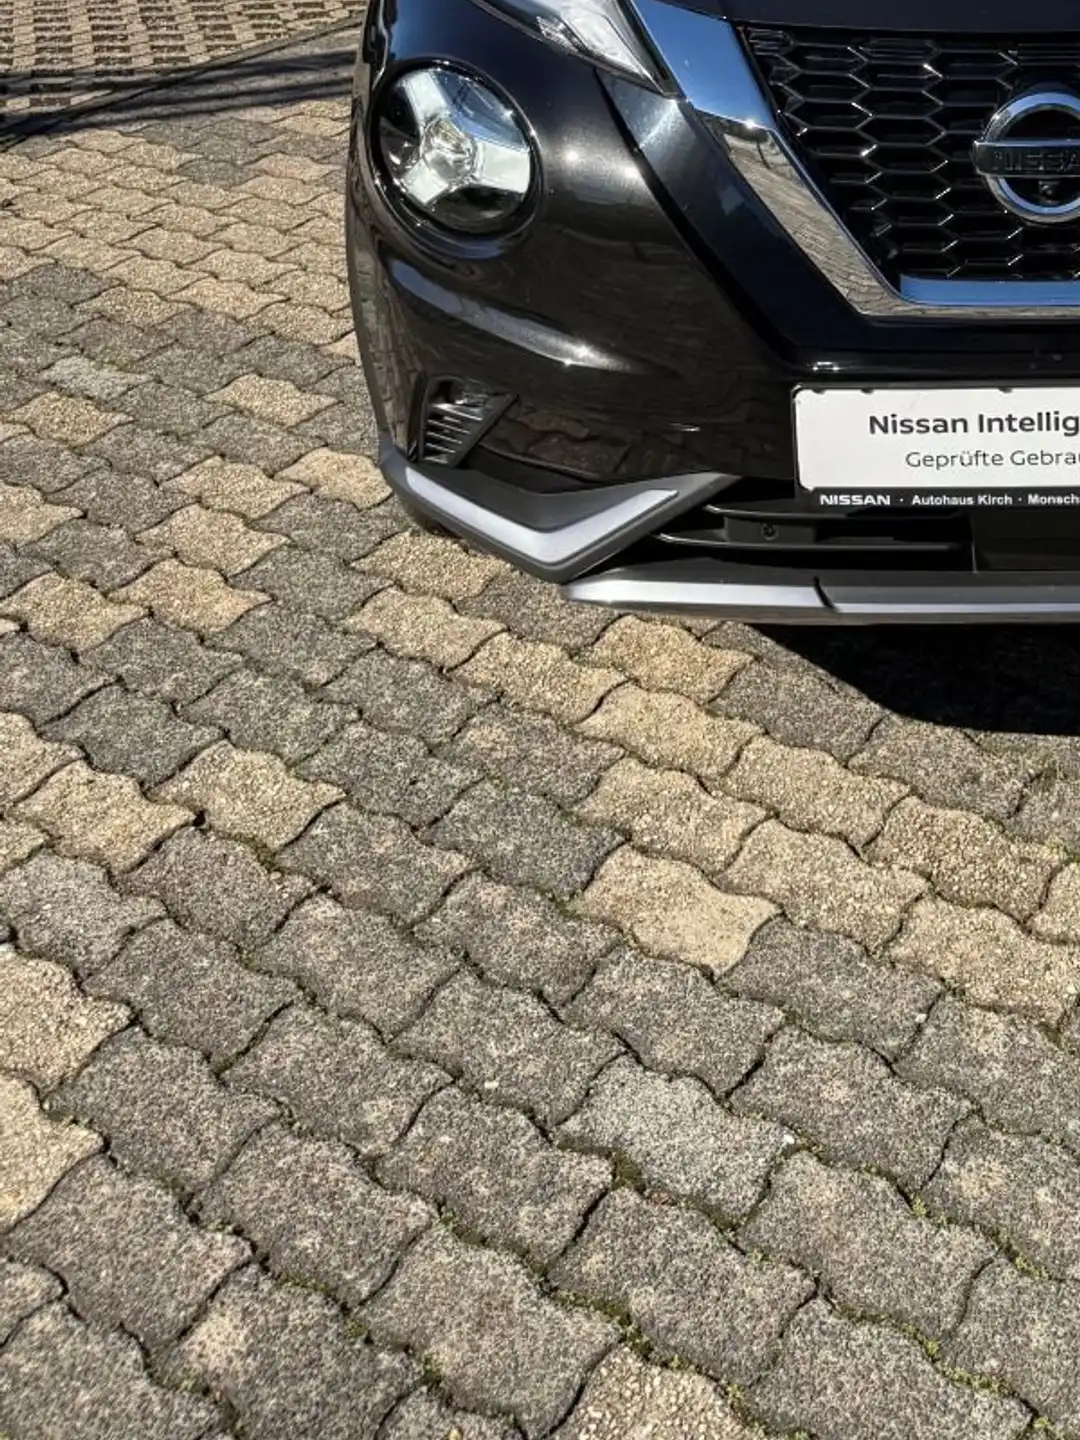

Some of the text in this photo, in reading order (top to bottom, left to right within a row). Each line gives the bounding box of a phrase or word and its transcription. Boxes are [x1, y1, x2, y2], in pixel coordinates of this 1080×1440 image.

[869, 413, 969, 435] Nissan
[905, 449, 1004, 470] Geprüfte
[819, 494, 891, 506] NISSAN
[911, 494, 974, 506] Autohaus
[977, 494, 1013, 506] Kirch
